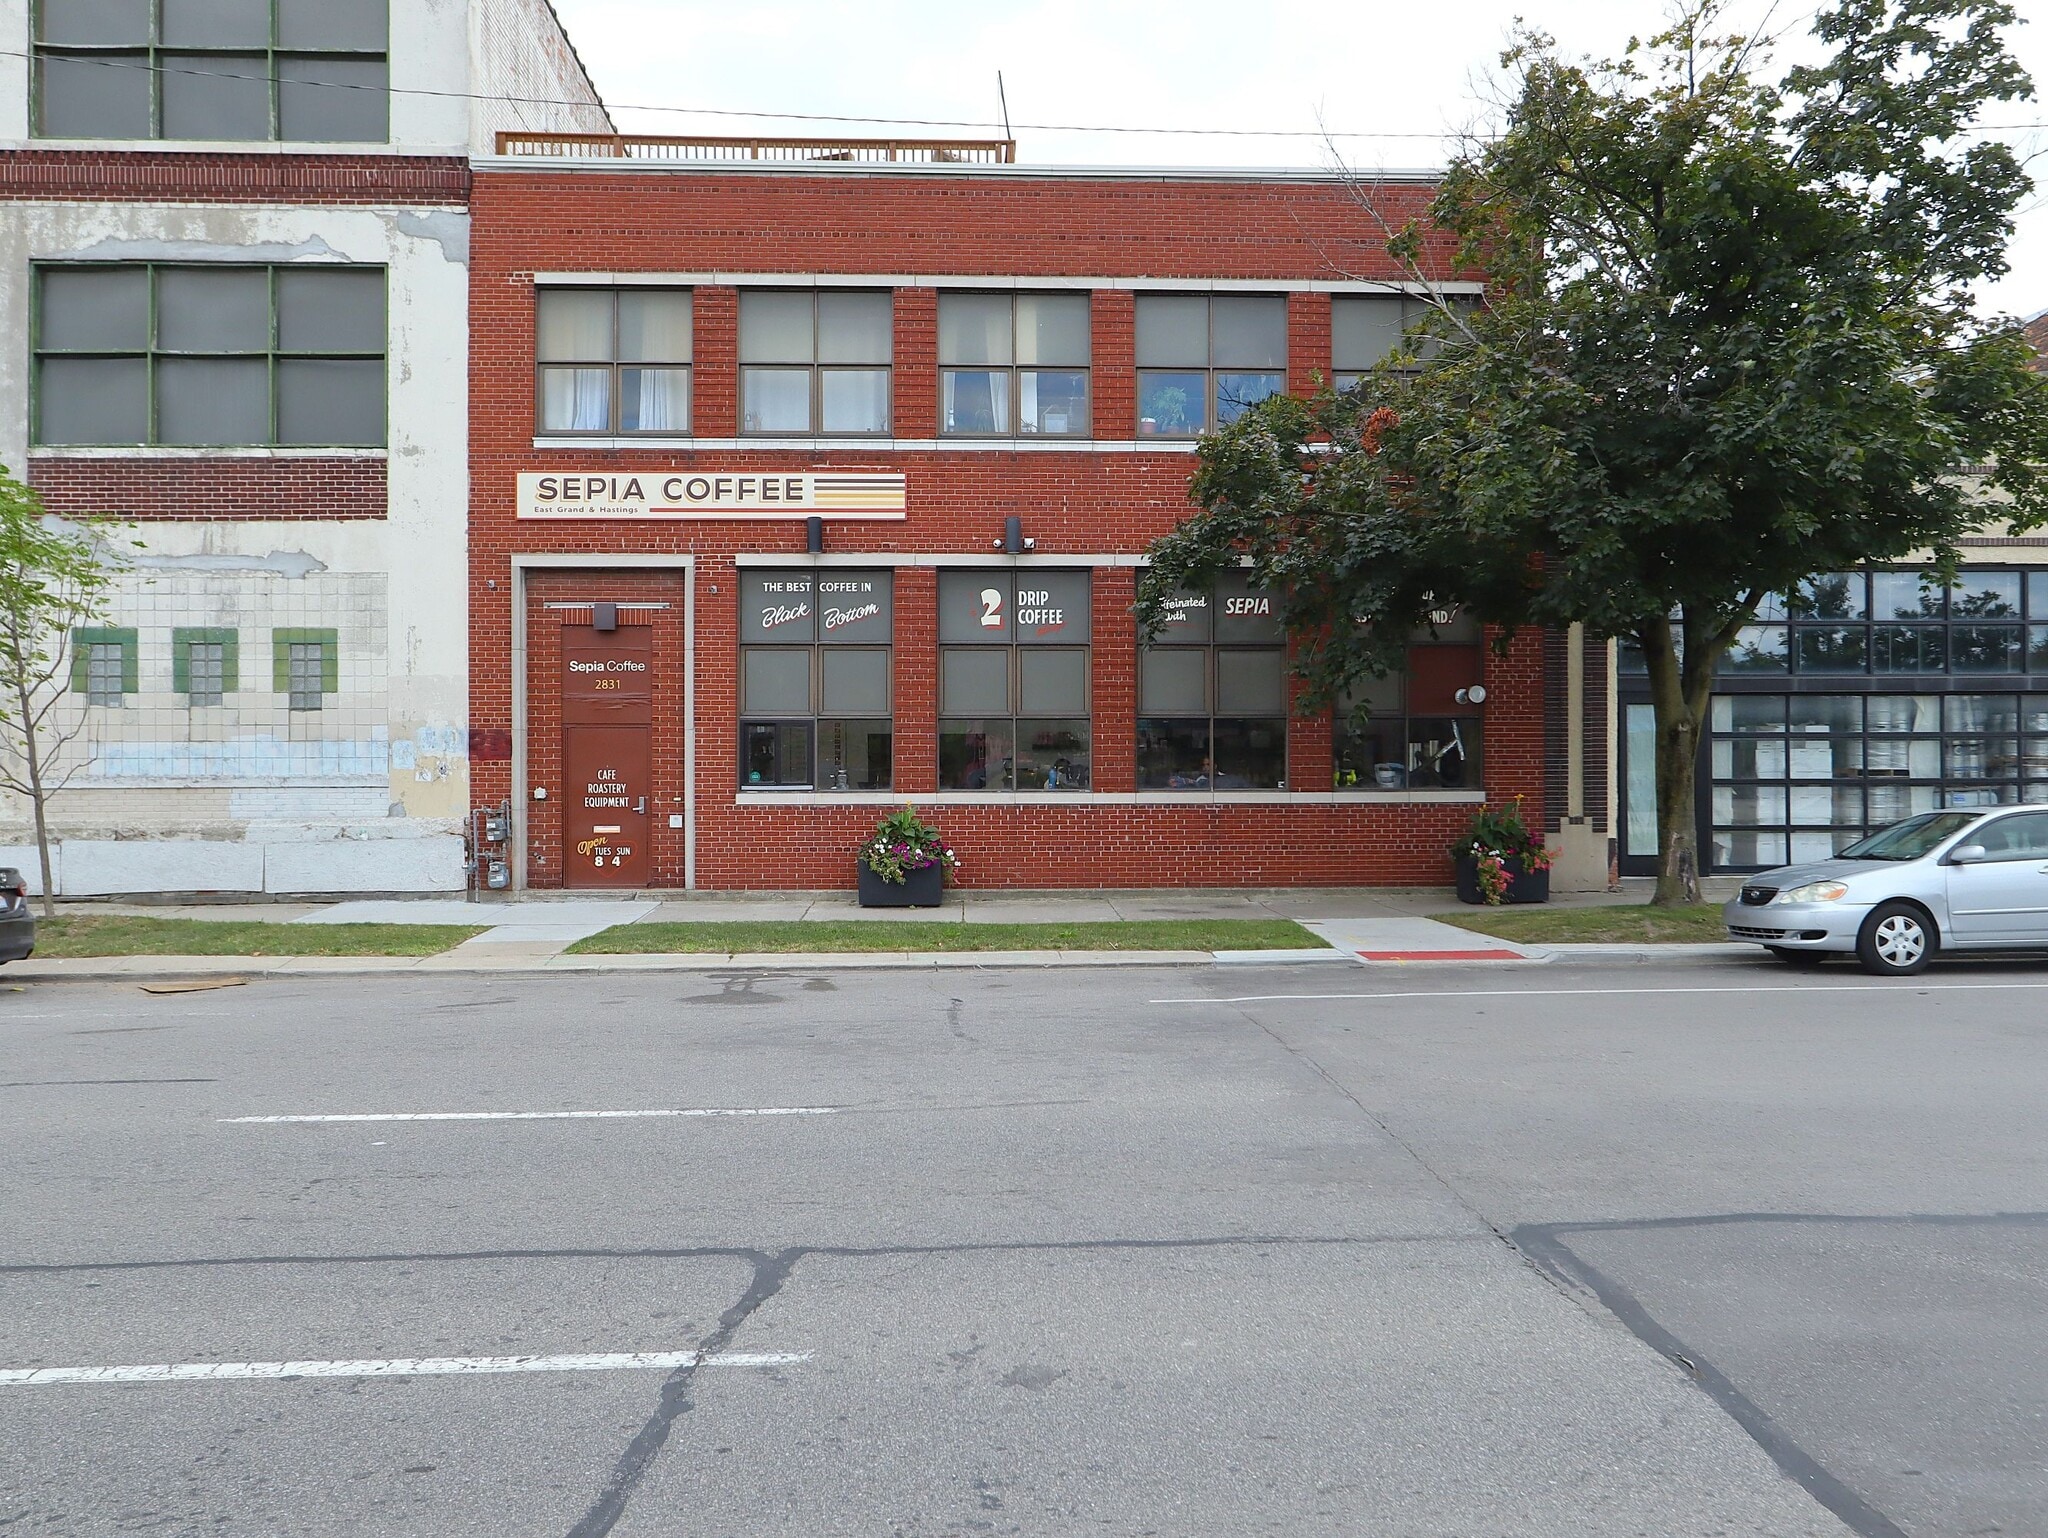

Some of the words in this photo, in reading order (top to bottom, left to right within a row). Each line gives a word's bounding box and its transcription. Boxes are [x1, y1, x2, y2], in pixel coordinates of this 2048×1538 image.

[536, 477, 645, 502] SEPIA
[662, 477, 803, 502] COFFEE
[599, 506, 638, 514] Hastings
[763, 582, 784, 592] THE
[786, 582, 811, 592] BEST
[819, 582, 858, 592] COFFEE
[861, 582, 872, 592] IN
[1018, 590, 1049, 606] DRIP
[980, 588, 1002, 627] 2
[1225, 597, 1270, 615] SEPIA
[761, 602, 811, 628] Black
[823, 603, 880, 629] Bottom
[1017, 609, 1063, 625] COFFEE
[569, 660, 605, 674] Sepia
[606, 660, 646, 672] Coffee
[595, 679, 621, 690] 2831
[597, 769, 617, 780] CAFE
[587, 783, 627, 794] ROASTERY
[584, 797, 630, 808] EQUIPMENT
[577, 835, 609, 856] Open
[594, 847, 612, 856] TUES
[616, 847, 631, 856] SUN
[594, 856, 604, 867] 8
[611, 856, 621, 867] 4
